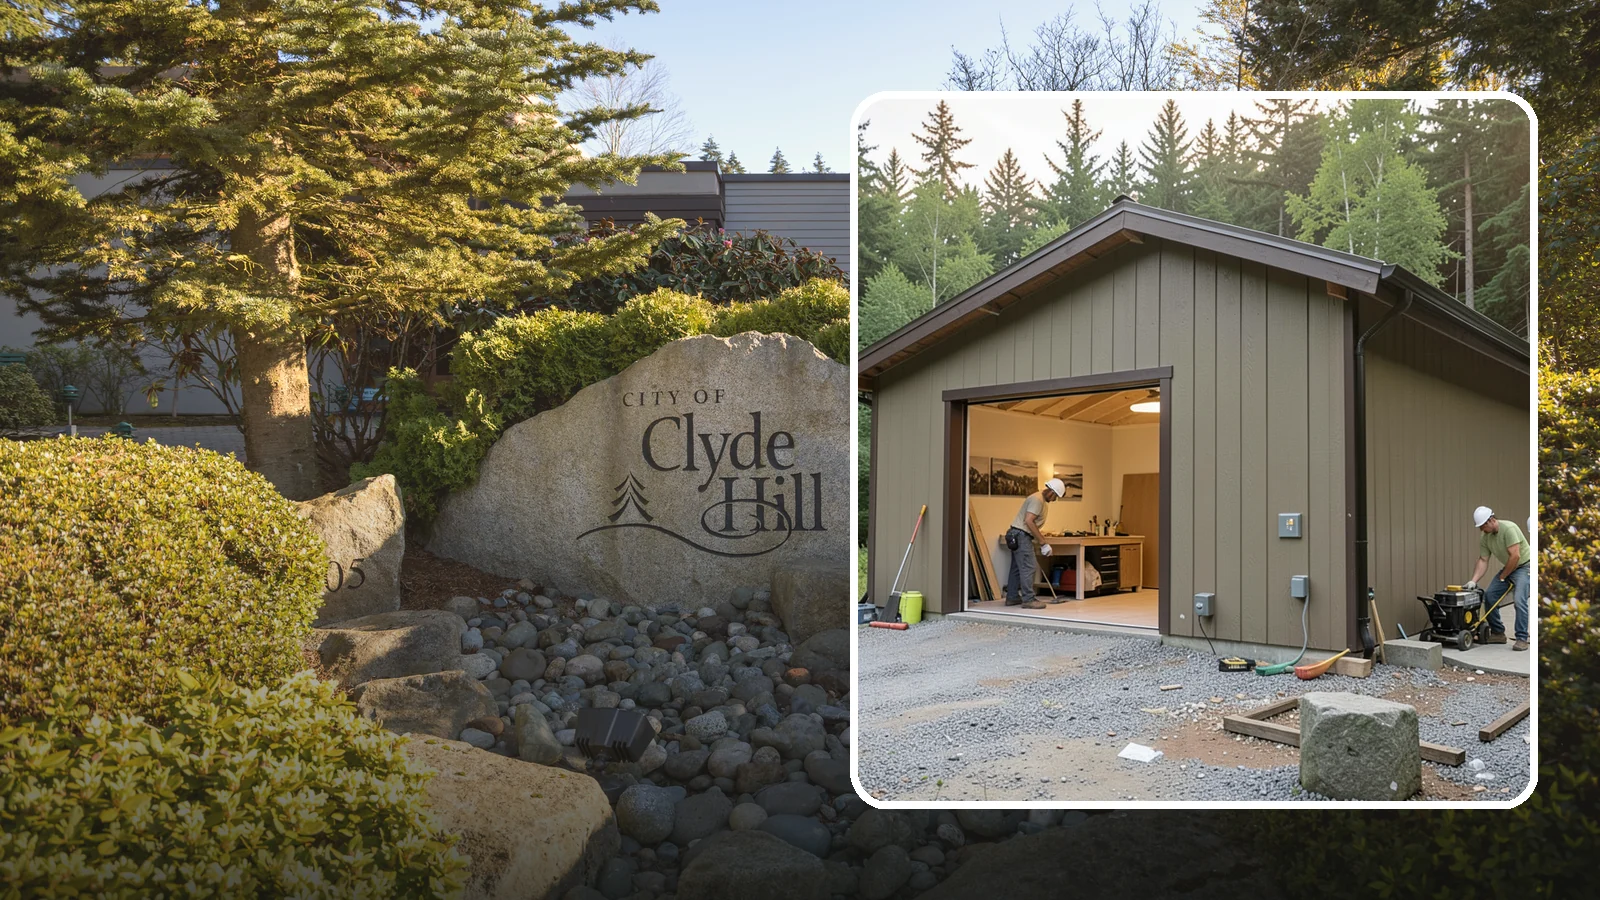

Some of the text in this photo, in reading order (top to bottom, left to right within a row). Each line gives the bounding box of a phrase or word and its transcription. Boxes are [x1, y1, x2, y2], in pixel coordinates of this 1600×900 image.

[622, 389, 725, 407] CITY OF
[641, 411, 795, 493] Clyde
[717, 472, 828, 532] Hill
